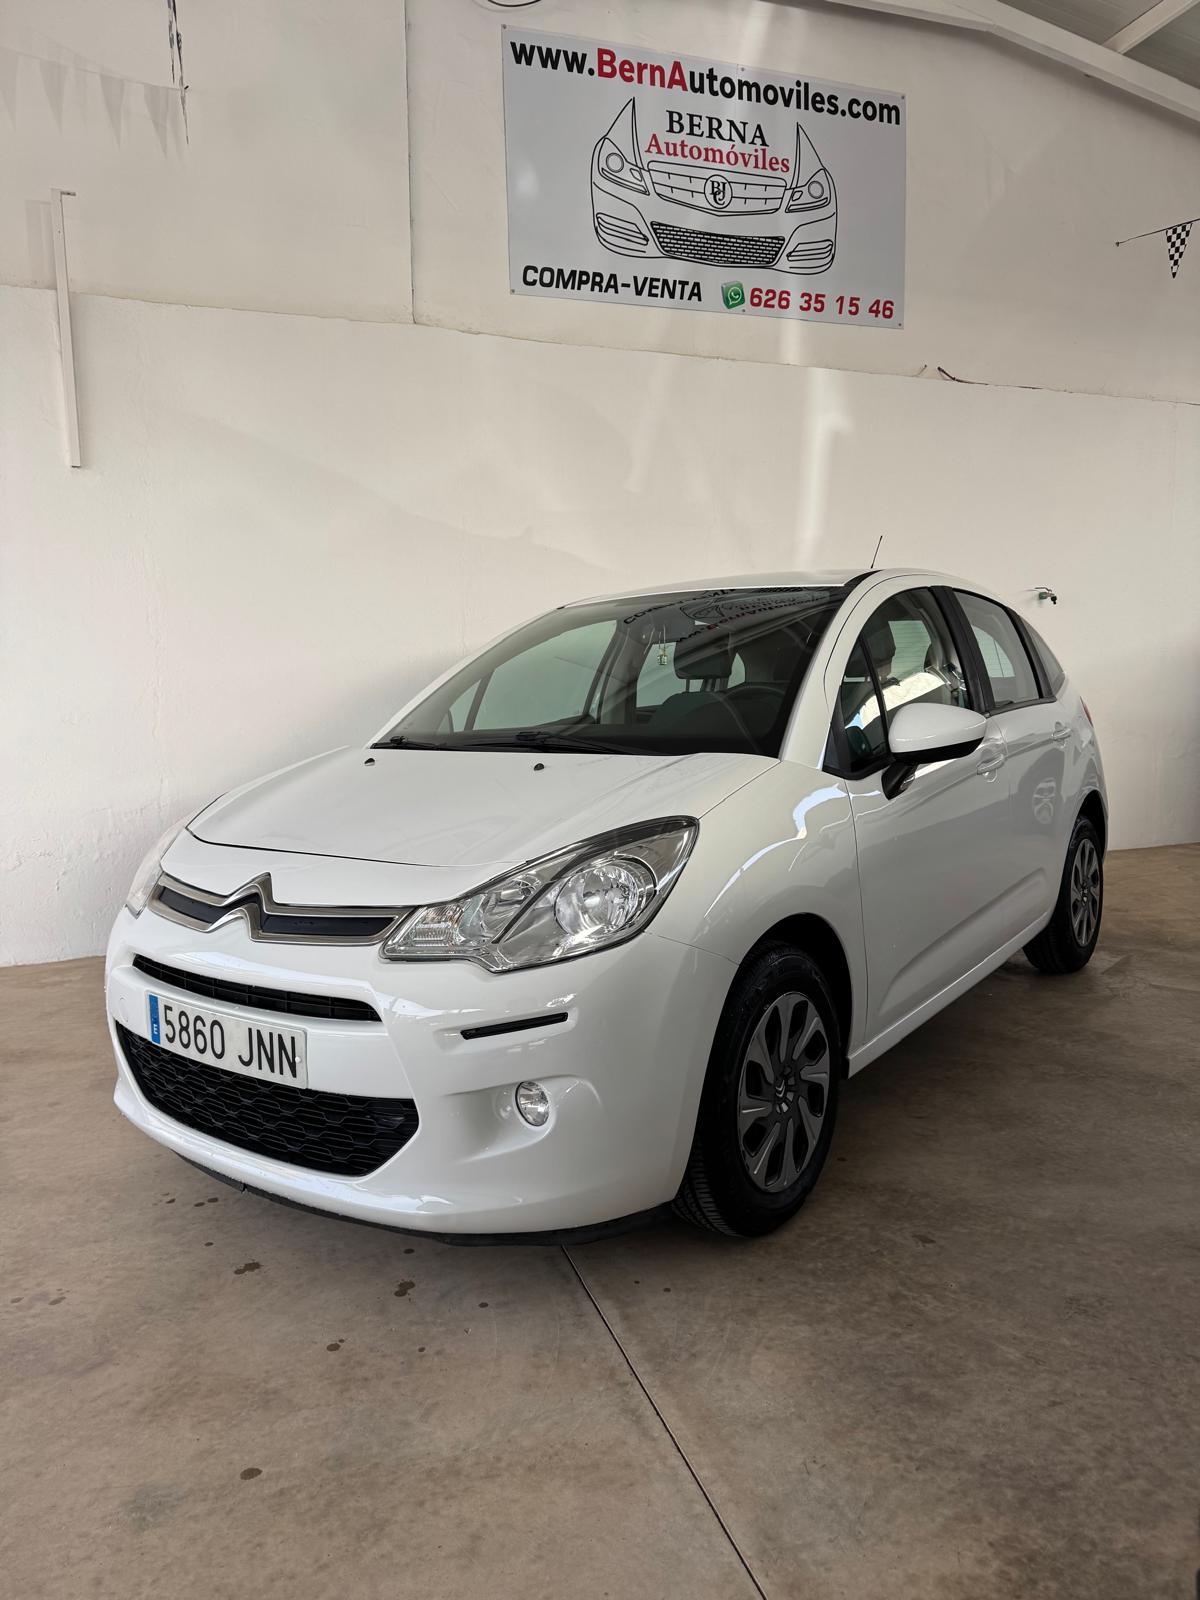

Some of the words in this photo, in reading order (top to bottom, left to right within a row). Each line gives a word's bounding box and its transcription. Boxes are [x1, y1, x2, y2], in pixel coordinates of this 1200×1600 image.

[510, 41, 901, 126] www.BernAutomoviles.com
[666, 110, 769, 147] BERNA
[644, 133, 790, 173] Automóviles
[522, 265, 702, 302] COMPRA-VENTA
[749, 288, 791, 310] 626
[799, 292, 826, 314] 35
[835, 296, 860, 317] 15
[868, 299, 895, 320] 46
[164, 1004, 225, 1060] 5860
[238, 1028, 297, 1078] JNN
